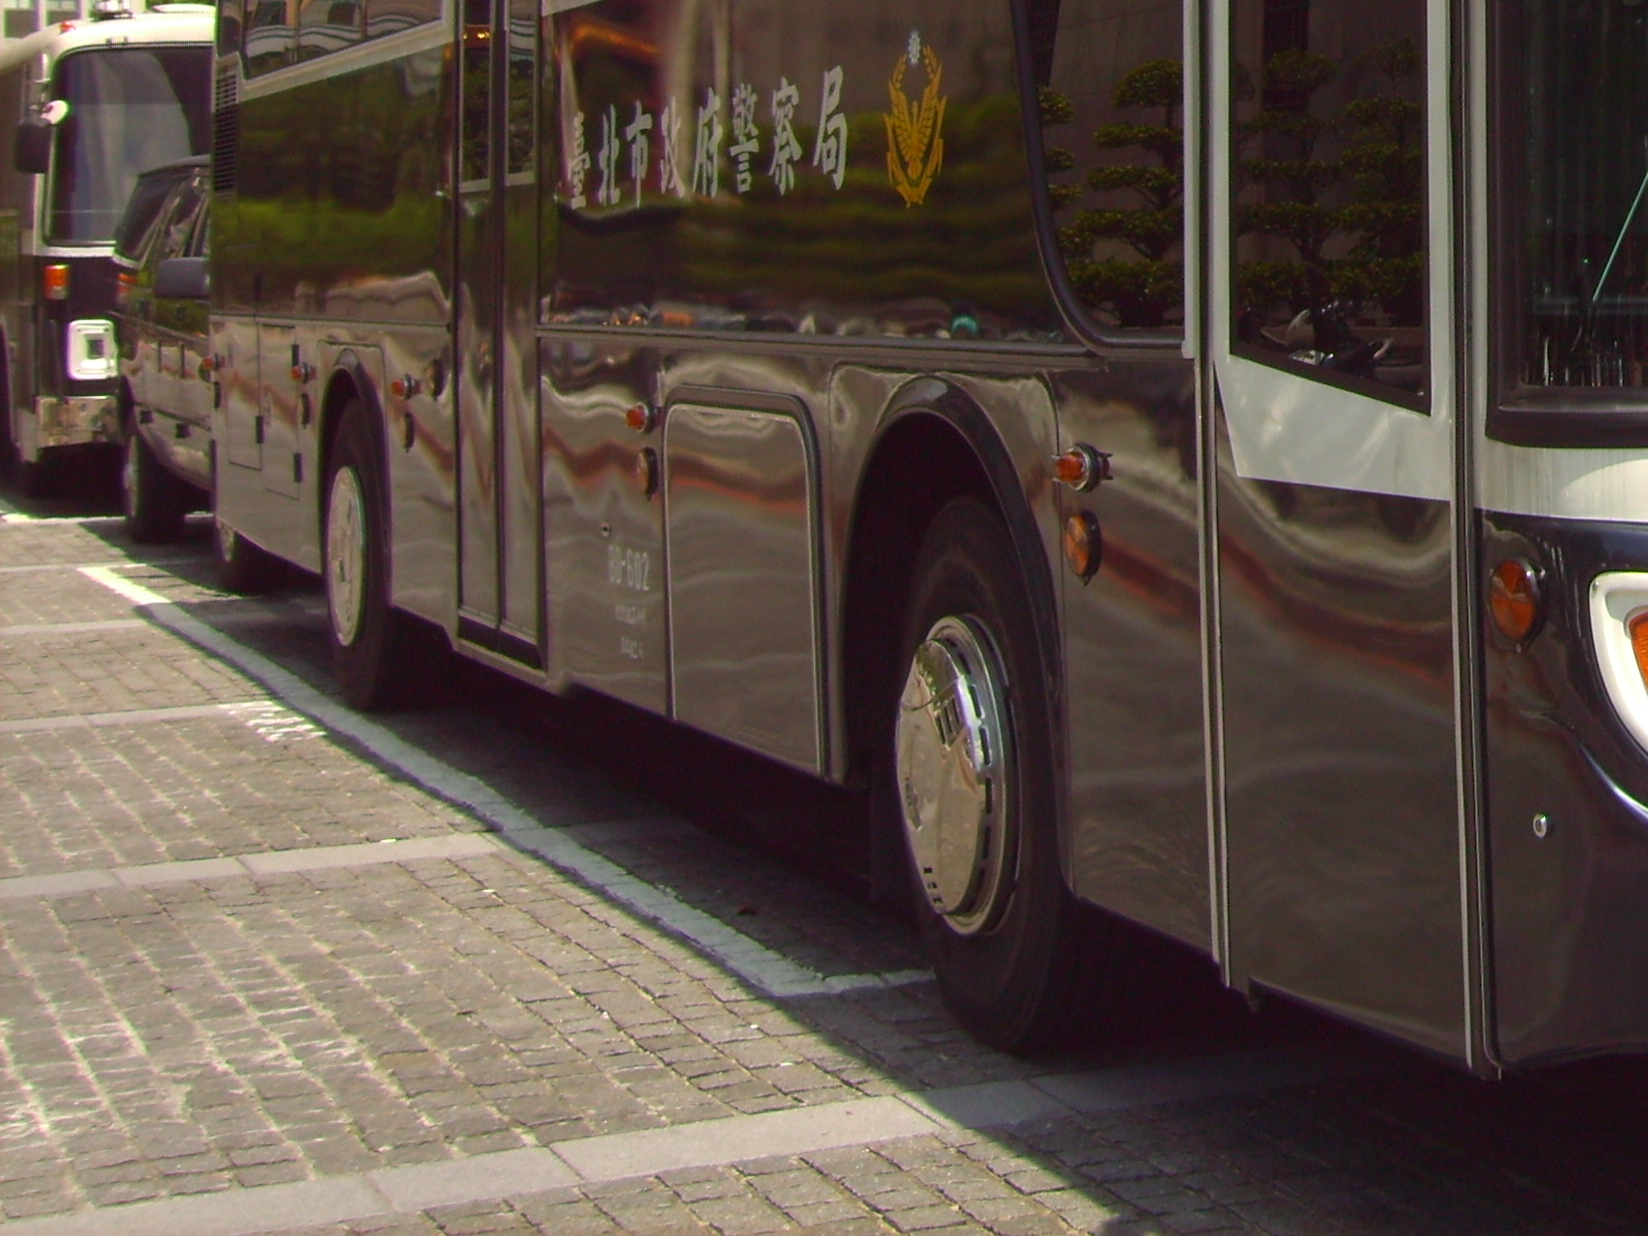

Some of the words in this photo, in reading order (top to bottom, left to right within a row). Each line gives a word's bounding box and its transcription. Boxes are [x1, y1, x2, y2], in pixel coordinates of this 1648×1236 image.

[567, 65, 848, 210] 臺北市政府警察局
